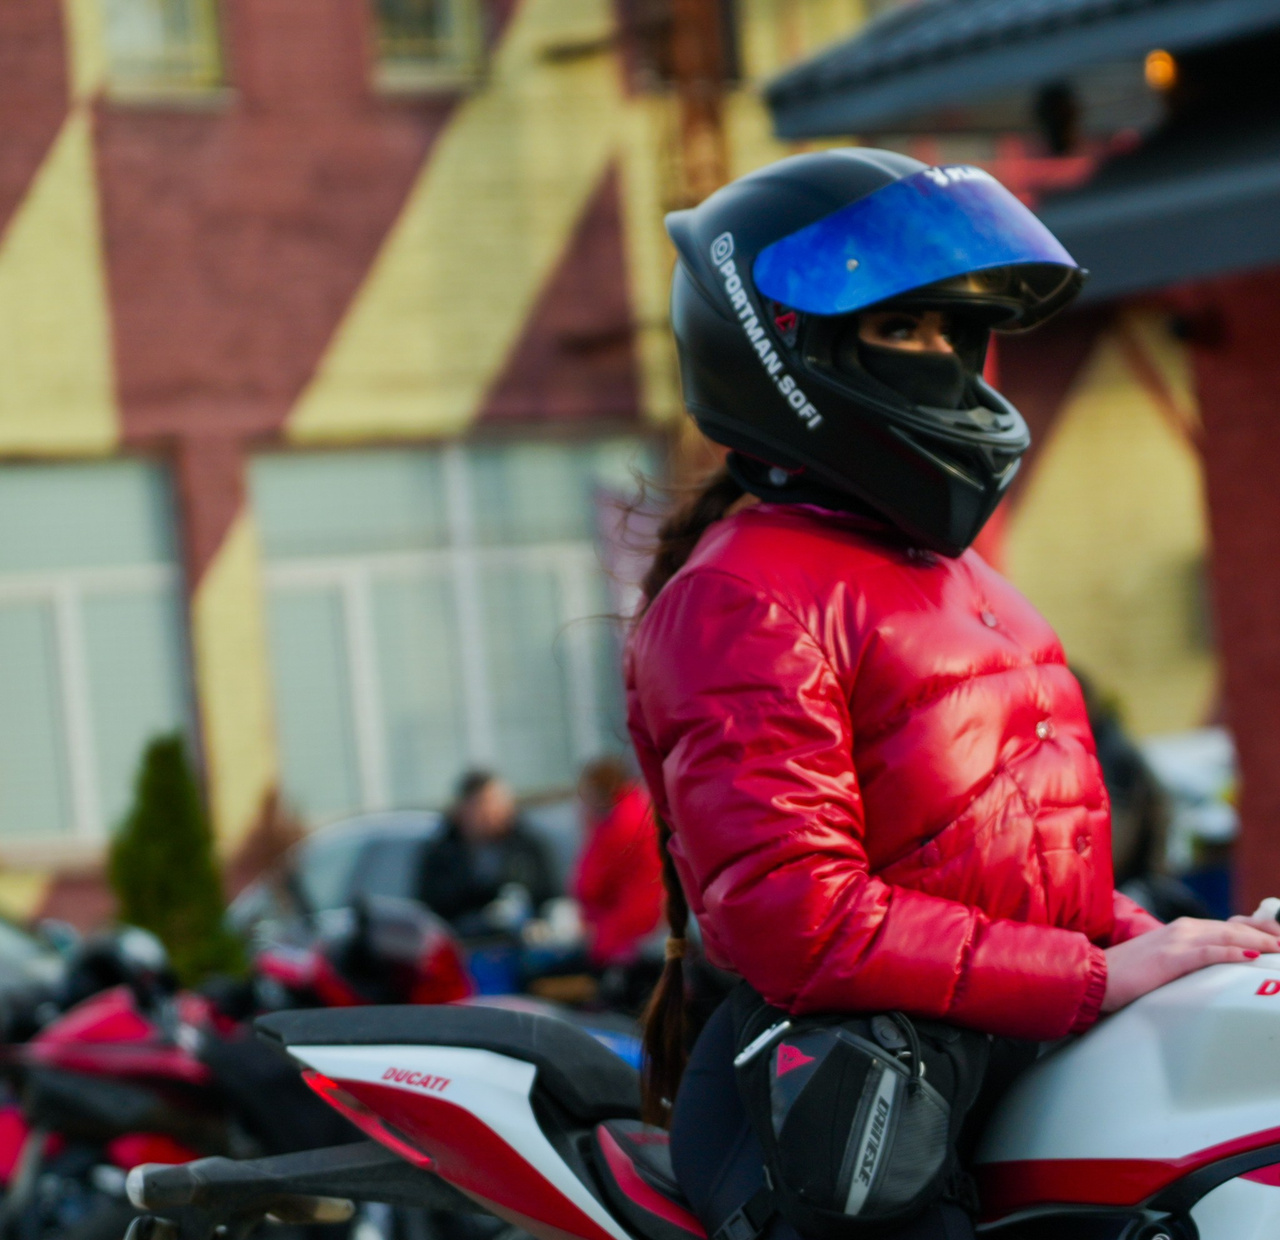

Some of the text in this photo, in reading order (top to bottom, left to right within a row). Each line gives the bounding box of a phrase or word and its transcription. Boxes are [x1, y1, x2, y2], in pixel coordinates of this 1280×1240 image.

[719, 259, 823, 430] PORTMAN.SOFI
[382, 1066, 451, 1092] DUCATI
[857, 1095, 890, 1187] DAINESE
